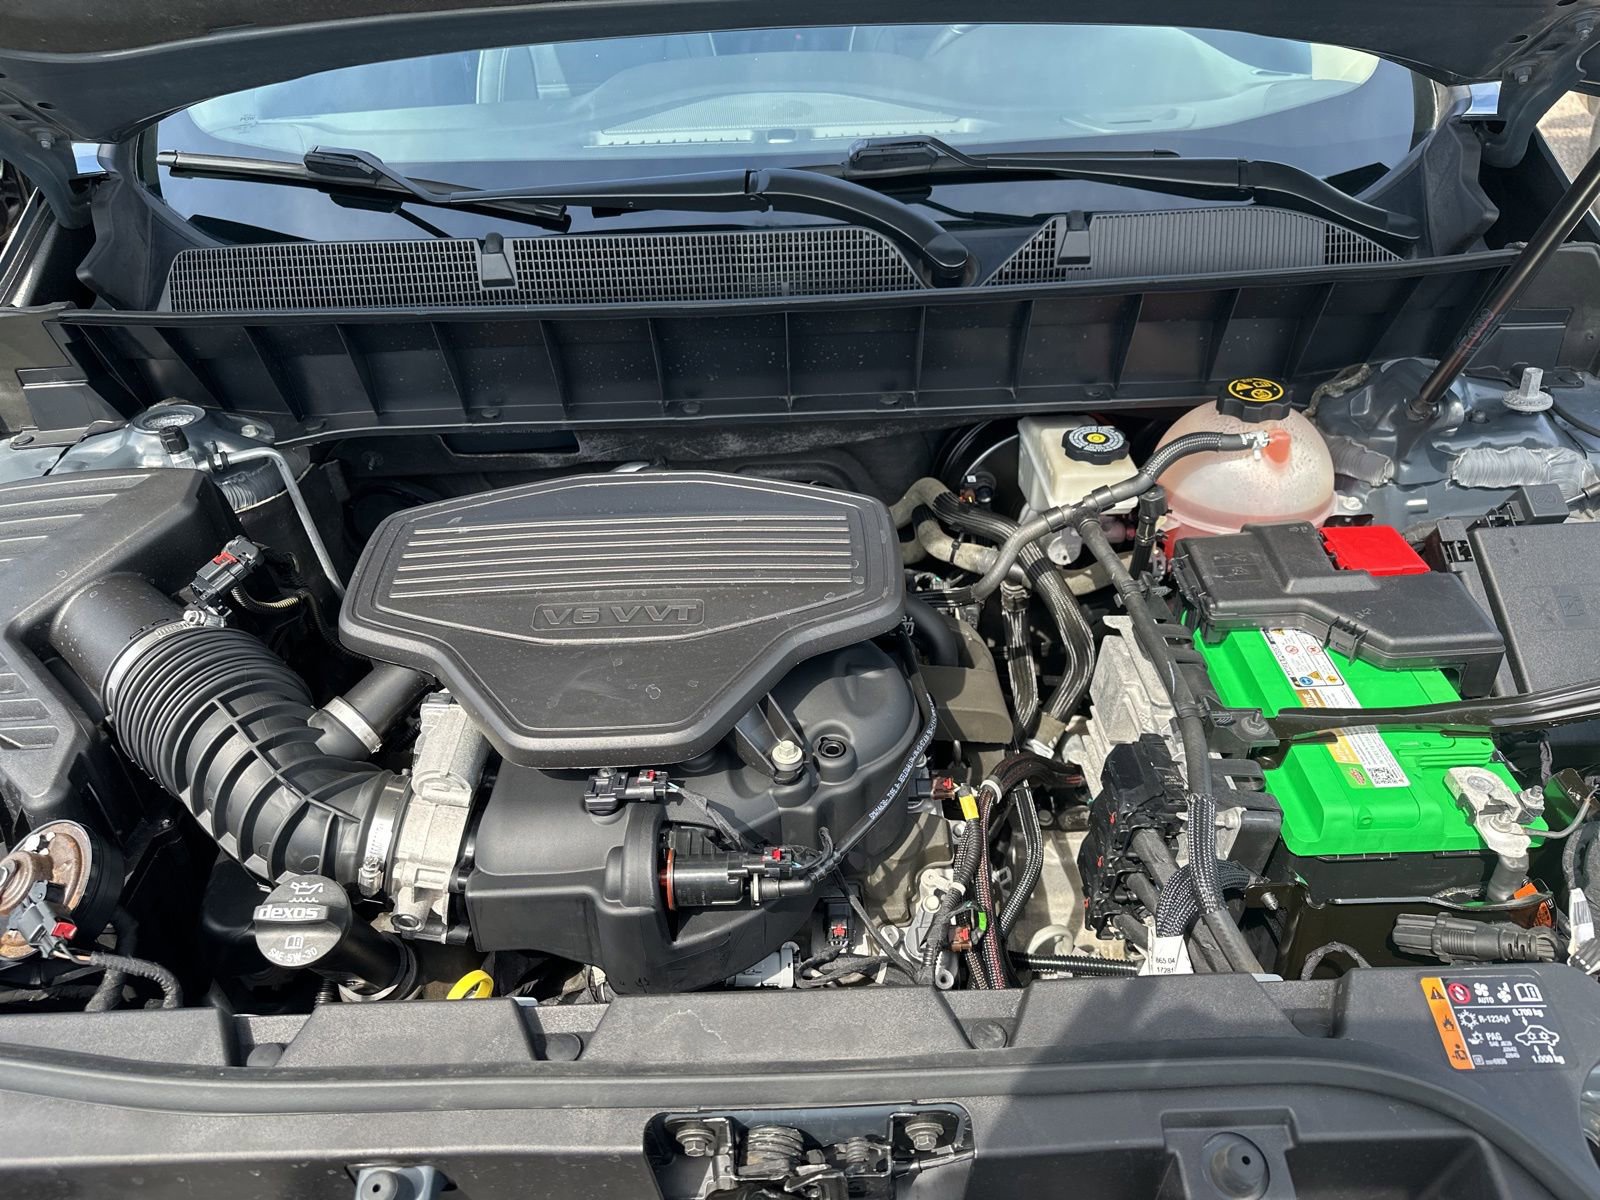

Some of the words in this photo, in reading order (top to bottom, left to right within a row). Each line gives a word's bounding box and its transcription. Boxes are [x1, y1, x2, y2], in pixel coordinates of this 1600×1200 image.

[543, 607, 600, 625] V6
[610, 604, 697, 623] VVT
[259, 905, 321, 919] dexos
[267, 948, 284, 960] SAE
[1532, 1008, 1544, 1017] kg
[1485, 1032, 1502, 1041] PAG
[1554, 1056, 1565, 1065] kg
